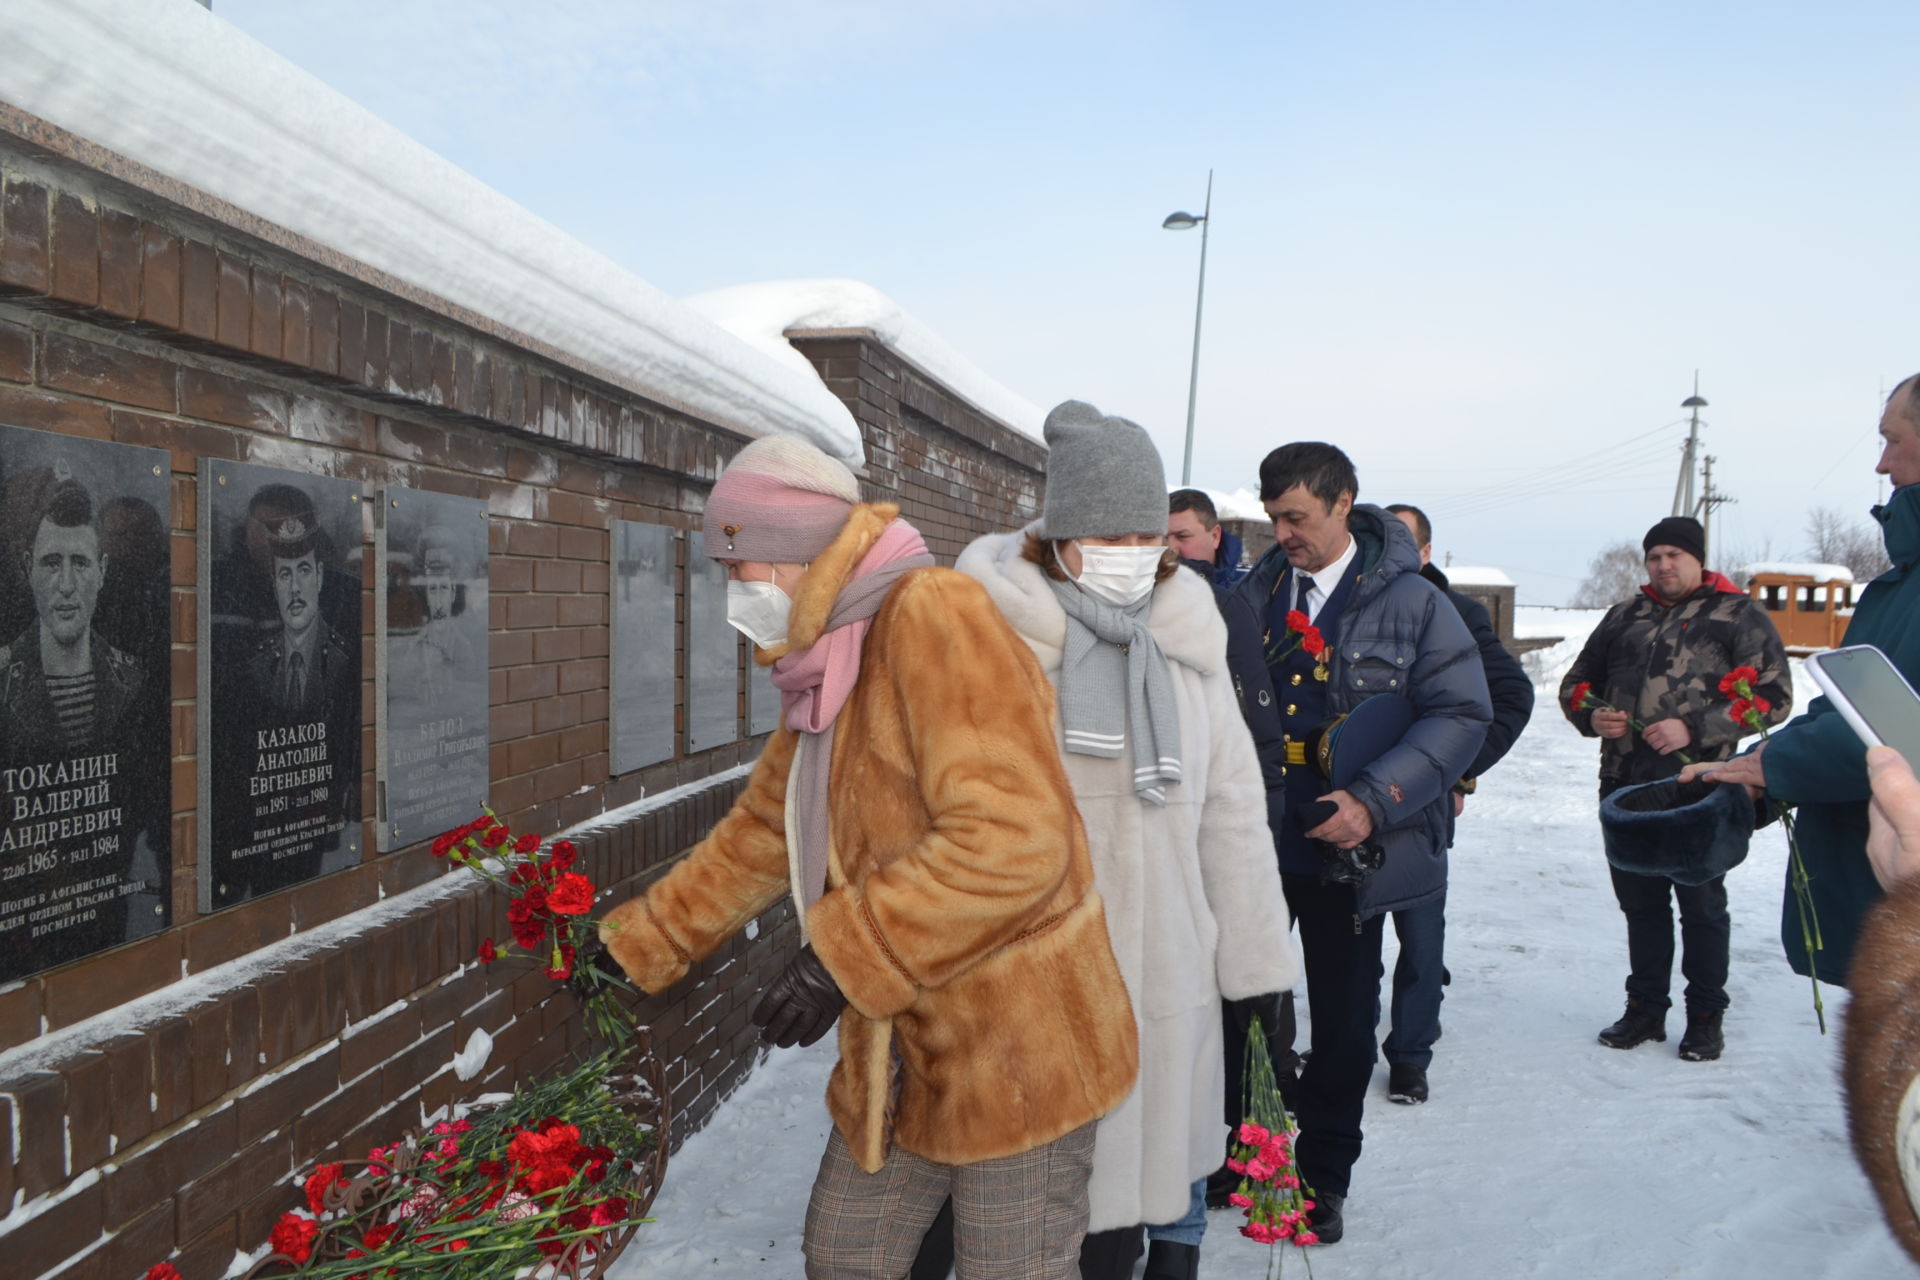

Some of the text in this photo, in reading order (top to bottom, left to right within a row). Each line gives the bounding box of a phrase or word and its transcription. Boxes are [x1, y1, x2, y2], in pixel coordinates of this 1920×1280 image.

[257, 722, 326, 750] КАЗАКОВ
[4, 753, 118, 793] ТОКАНИН
[256, 743, 327, 772] АНАТОЛИЙ
[249, 764, 333, 797] ЕВГЕНЬЕВИЧ
[13, 779, 110, 821] ВАЛЕРИЙ
[270, 796, 289, 813] 1951
[310, 787, 328, 804] 1980
[0, 807, 123, 853] АНДРЕЕВИЧ
[28, 849, 58, 874] 1965
[92, 834, 120, 858] 1984
